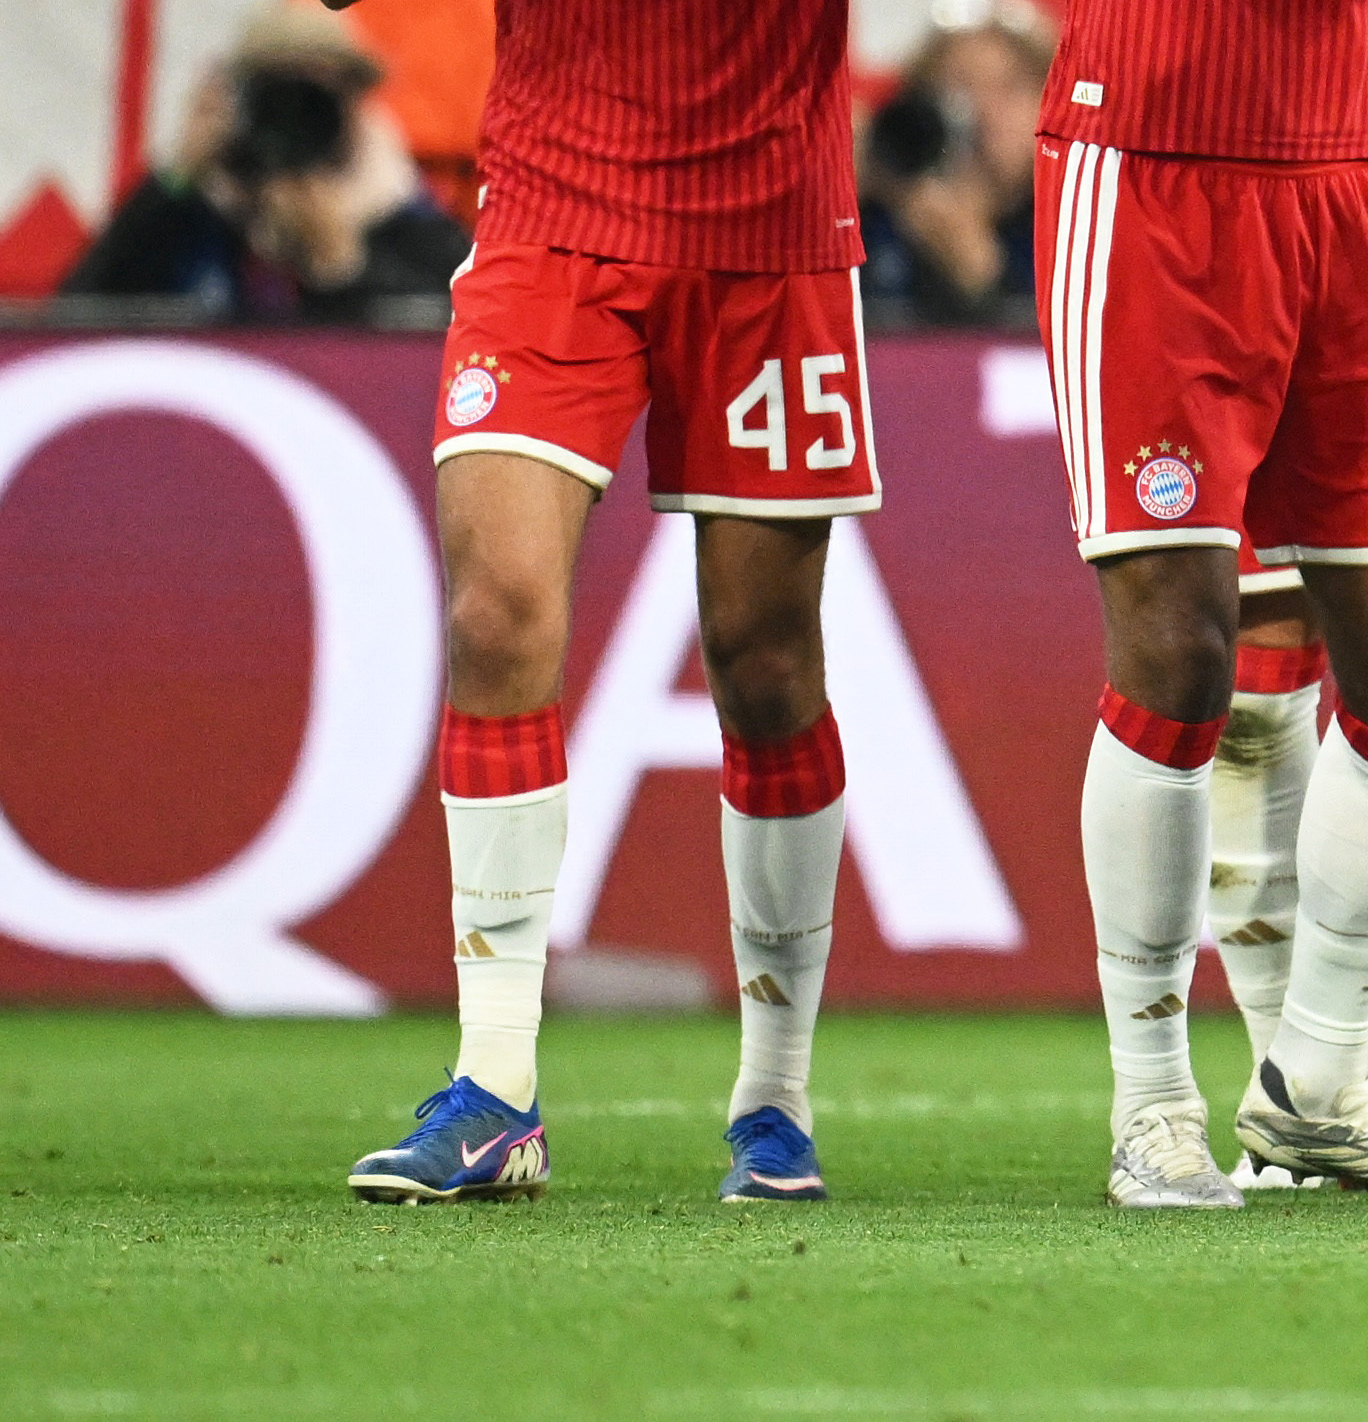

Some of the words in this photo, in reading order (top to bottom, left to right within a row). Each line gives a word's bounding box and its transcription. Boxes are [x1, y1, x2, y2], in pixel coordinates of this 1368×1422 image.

[726, 353, 857, 471] 45
[1152, 462, 1191, 485] BAYERN
[490, 890, 522, 901] MIA
